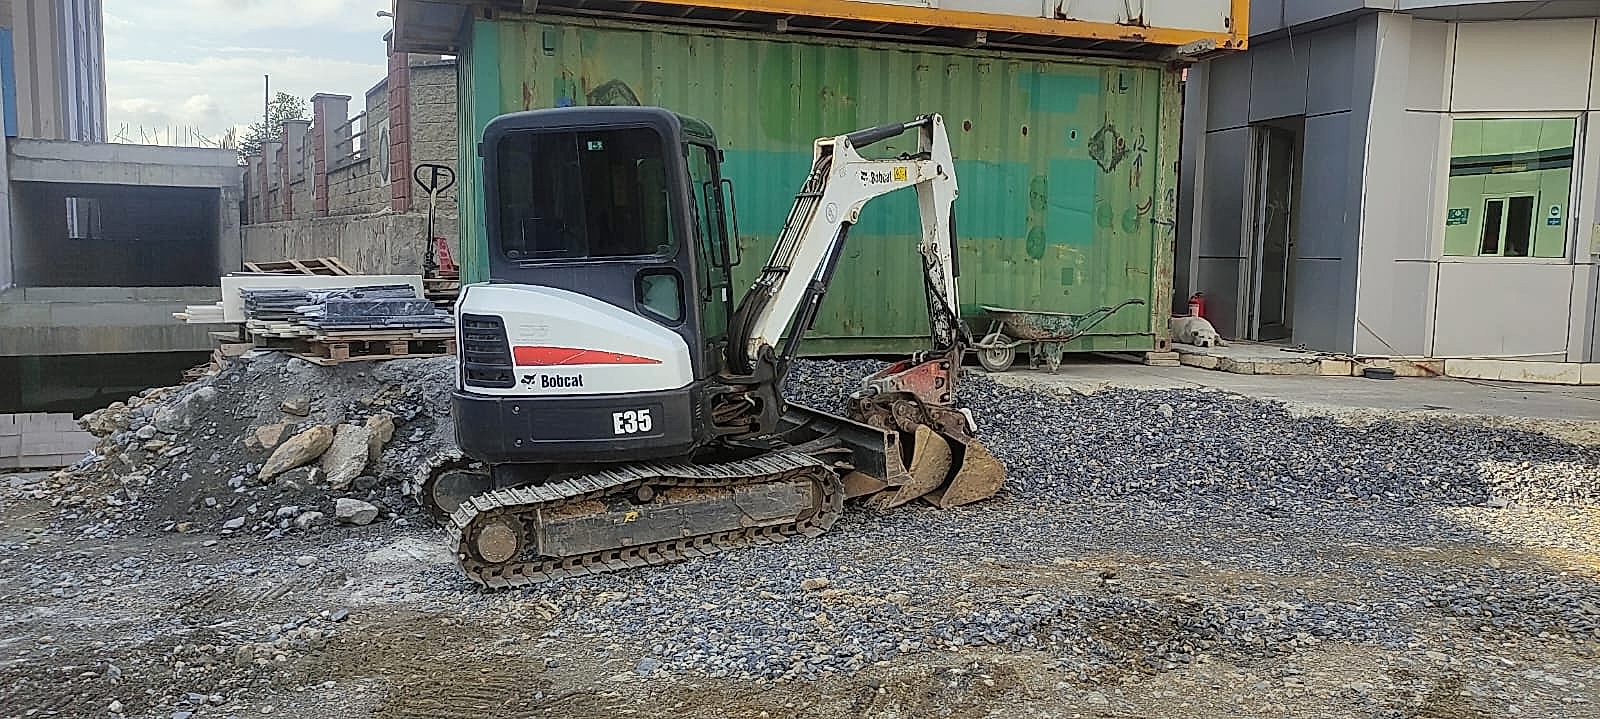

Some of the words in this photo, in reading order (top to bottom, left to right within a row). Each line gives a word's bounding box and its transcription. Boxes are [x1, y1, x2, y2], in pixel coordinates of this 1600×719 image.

[870, 171, 892, 184] Bobcat
[541, 374, 583, 388] Bobcat
[612, 408, 652, 435] E35
